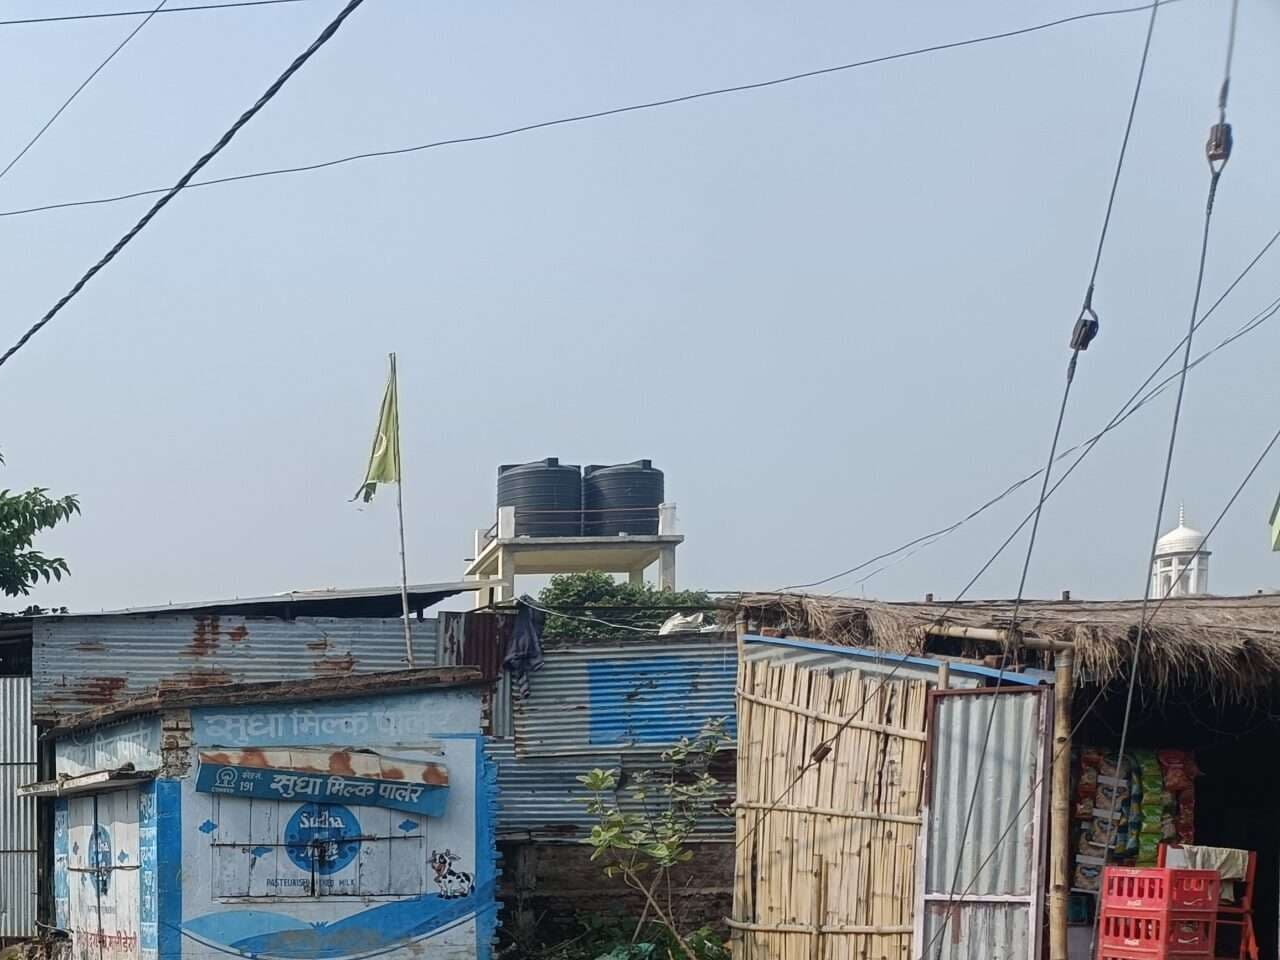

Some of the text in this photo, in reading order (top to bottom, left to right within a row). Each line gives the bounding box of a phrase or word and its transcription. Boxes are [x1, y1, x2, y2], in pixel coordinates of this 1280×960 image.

[203, 712, 287, 745] सुधा
[289, 708, 369, 737] मिल्क
[240, 781, 254, 792] 191
[270, 773, 425, 803] सुधा मिल्क पार्लर
[300, 809, 346, 829] Sudha
[300, 839, 340, 861] Mik
